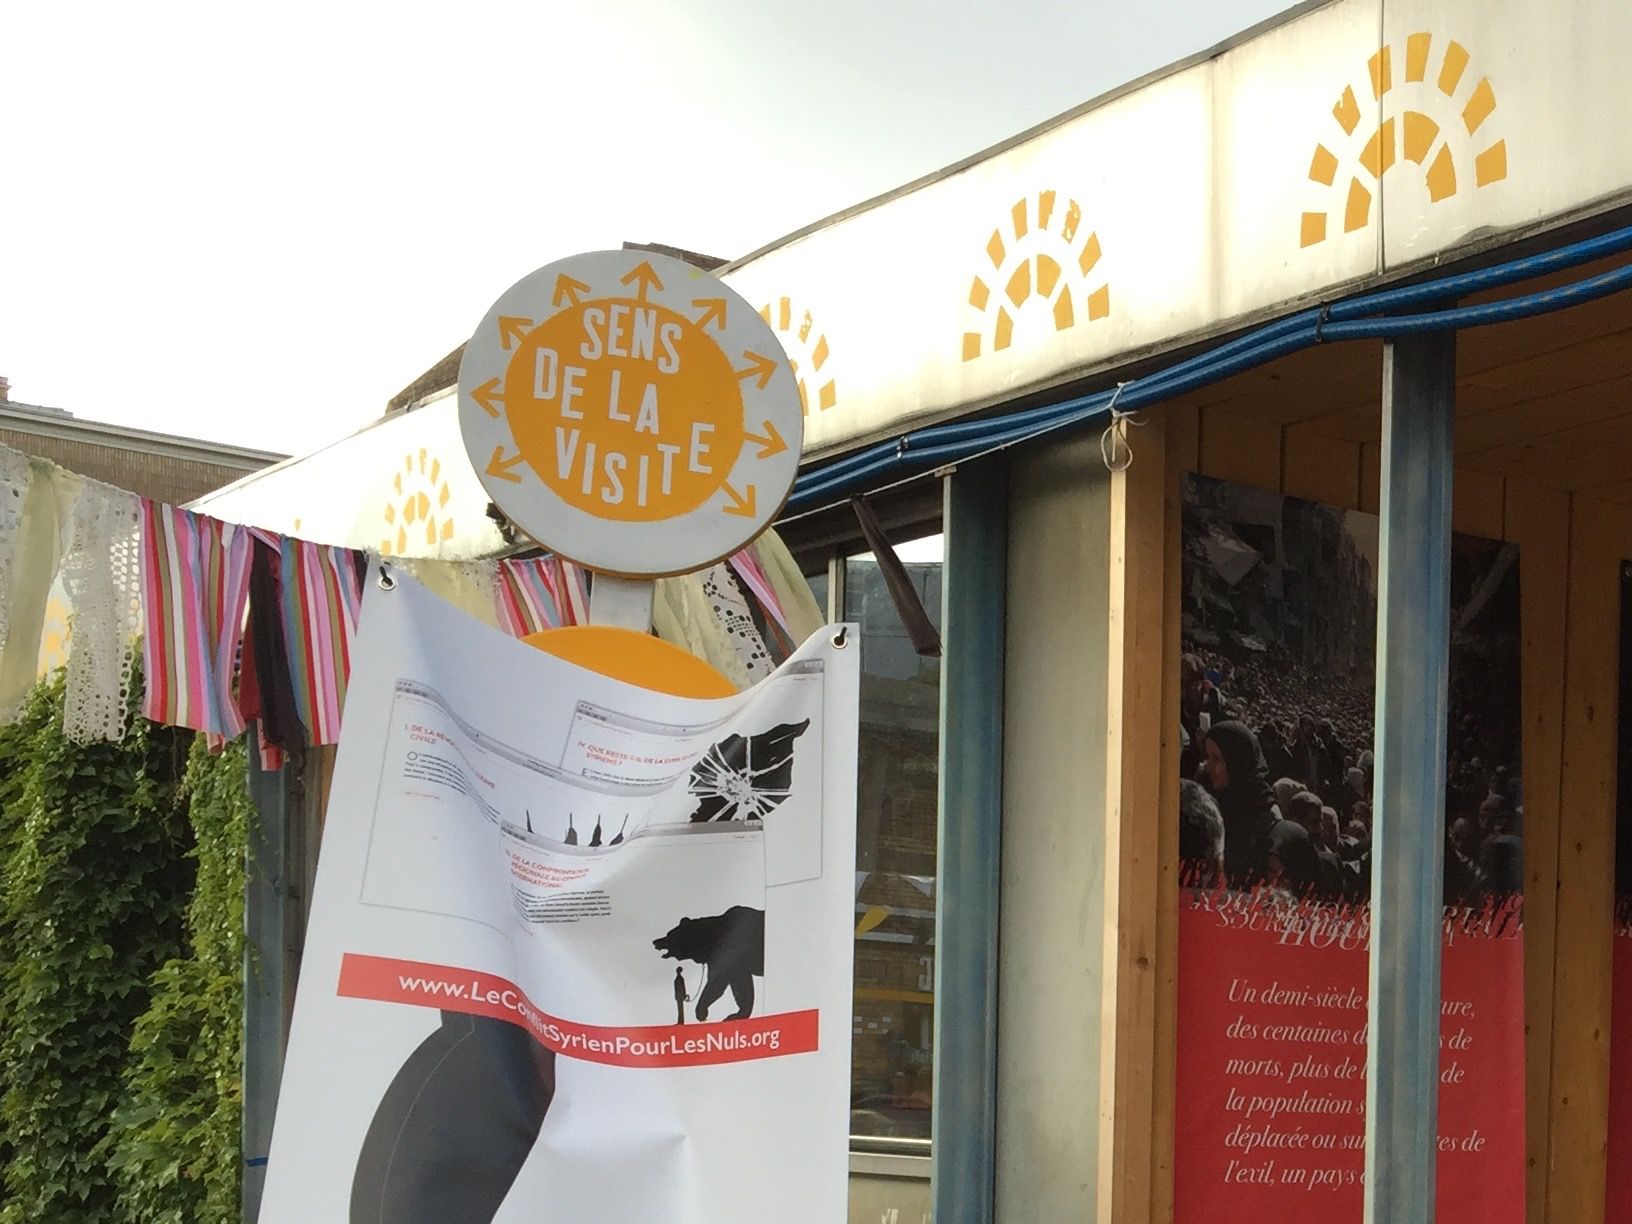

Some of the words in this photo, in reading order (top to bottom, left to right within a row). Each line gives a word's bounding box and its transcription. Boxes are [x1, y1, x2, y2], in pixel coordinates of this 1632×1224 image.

[580, 303, 683, 374] SENS
[533, 347, 587, 420] DE
[608, 370, 660, 435] LA
[554, 422, 715, 506] VISITE
[1228, 979, 1256, 1003] Un
[1261, 981, 1363, 1009] demi-siècle
[399, 975, 780, 1056] www.LeConflitSyrienPourLesNuls.org
[1226, 1015, 1259, 1039] des
[1263, 1022, 1350, 1044] centaines
[1353, 1023, 1367, 1045] d
[1448, 1028, 1472, 1049] de
[1225, 1058, 1284, 1077] morts,
[1287, 1055, 1329, 1084] plus
[1334, 1057, 1357, 1079] de
[1440, 1062, 1464, 1083] de
[1226, 1087, 1246, 1111] la
[1244, 1089, 1353, 1118] population
[1225, 1123, 1309, 1154] déplacée
[1312, 1134, 1336, 1149] ou
[1461, 1129, 1485, 1151] de
[1224, 1159, 1275, 1187] l'exil,
[1281, 1168, 1306, 1184] un
[1307, 1169, 1356, 1191] pays
